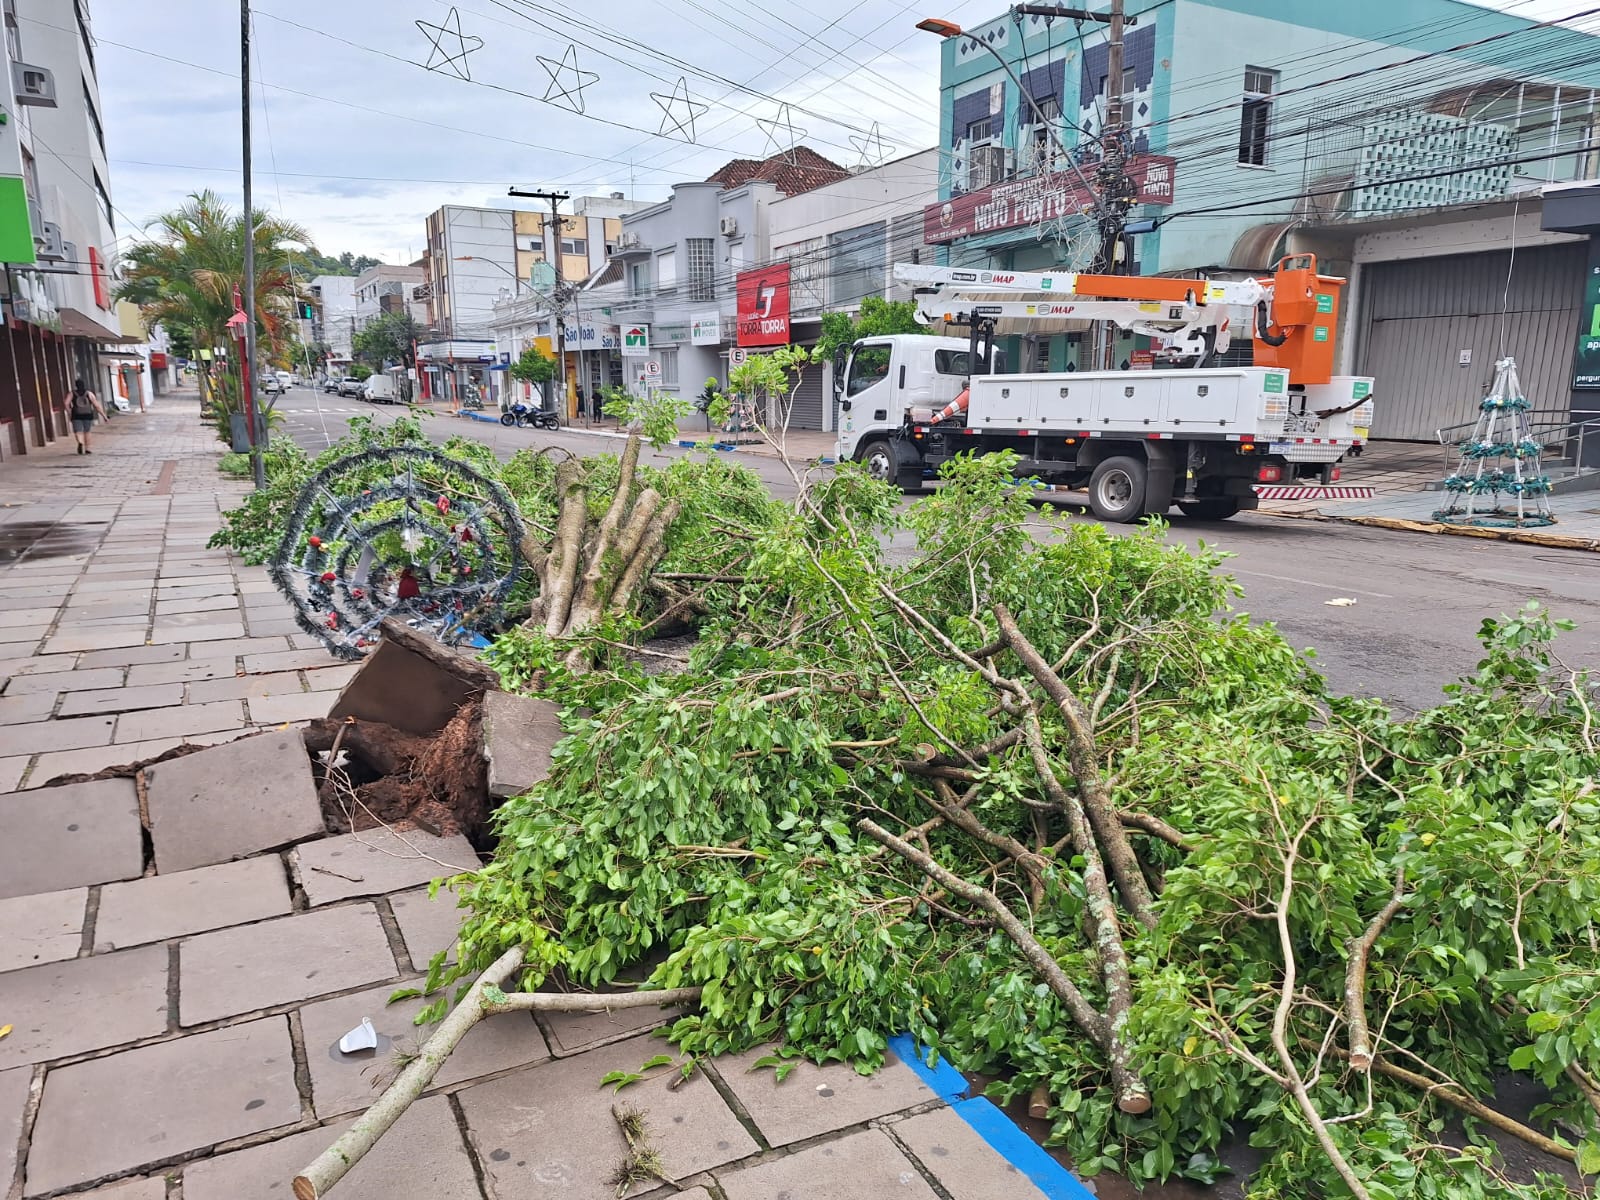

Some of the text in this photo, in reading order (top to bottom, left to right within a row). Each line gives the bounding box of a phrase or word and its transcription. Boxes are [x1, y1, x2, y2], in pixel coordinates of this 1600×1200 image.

[974, 191, 1066, 231] NOVO PONTO
[565, 326, 577, 342] São
[579, 324, 595, 340] João
[740, 319, 786, 336] TORRATORRA
[650, 364, 657, 373] E
